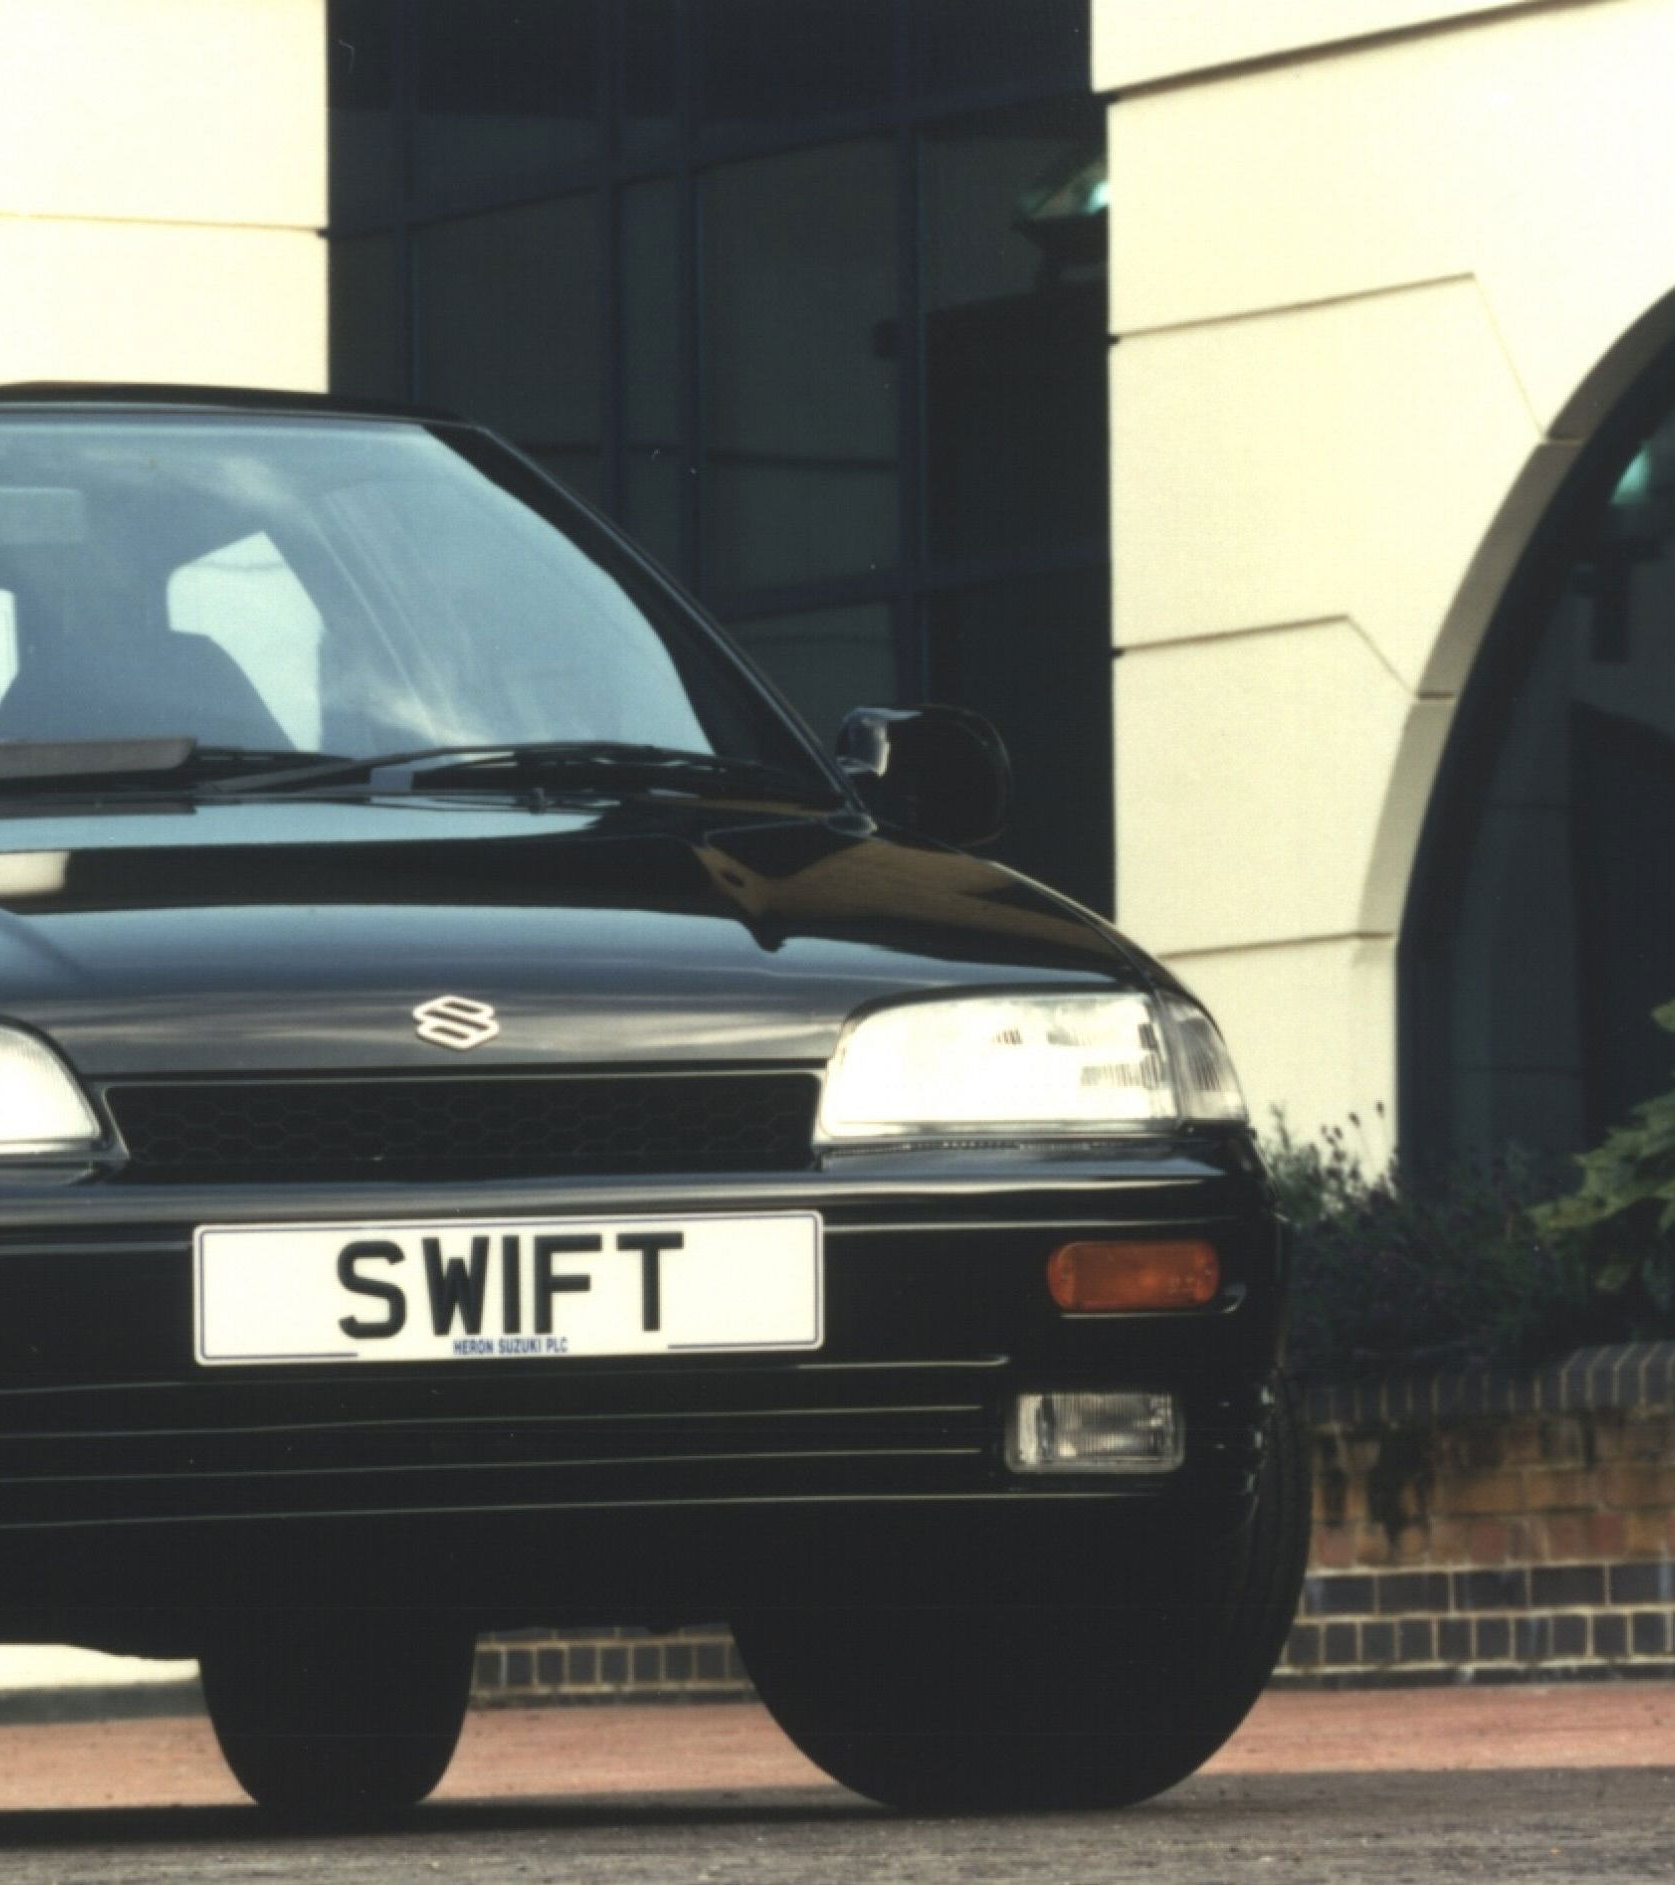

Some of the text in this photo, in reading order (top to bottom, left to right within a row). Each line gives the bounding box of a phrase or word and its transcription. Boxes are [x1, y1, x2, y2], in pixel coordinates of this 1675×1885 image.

[337, 1231, 684, 1340] SWIFT
[453, 1336, 568, 1355] HERON SUZUKI PLC
